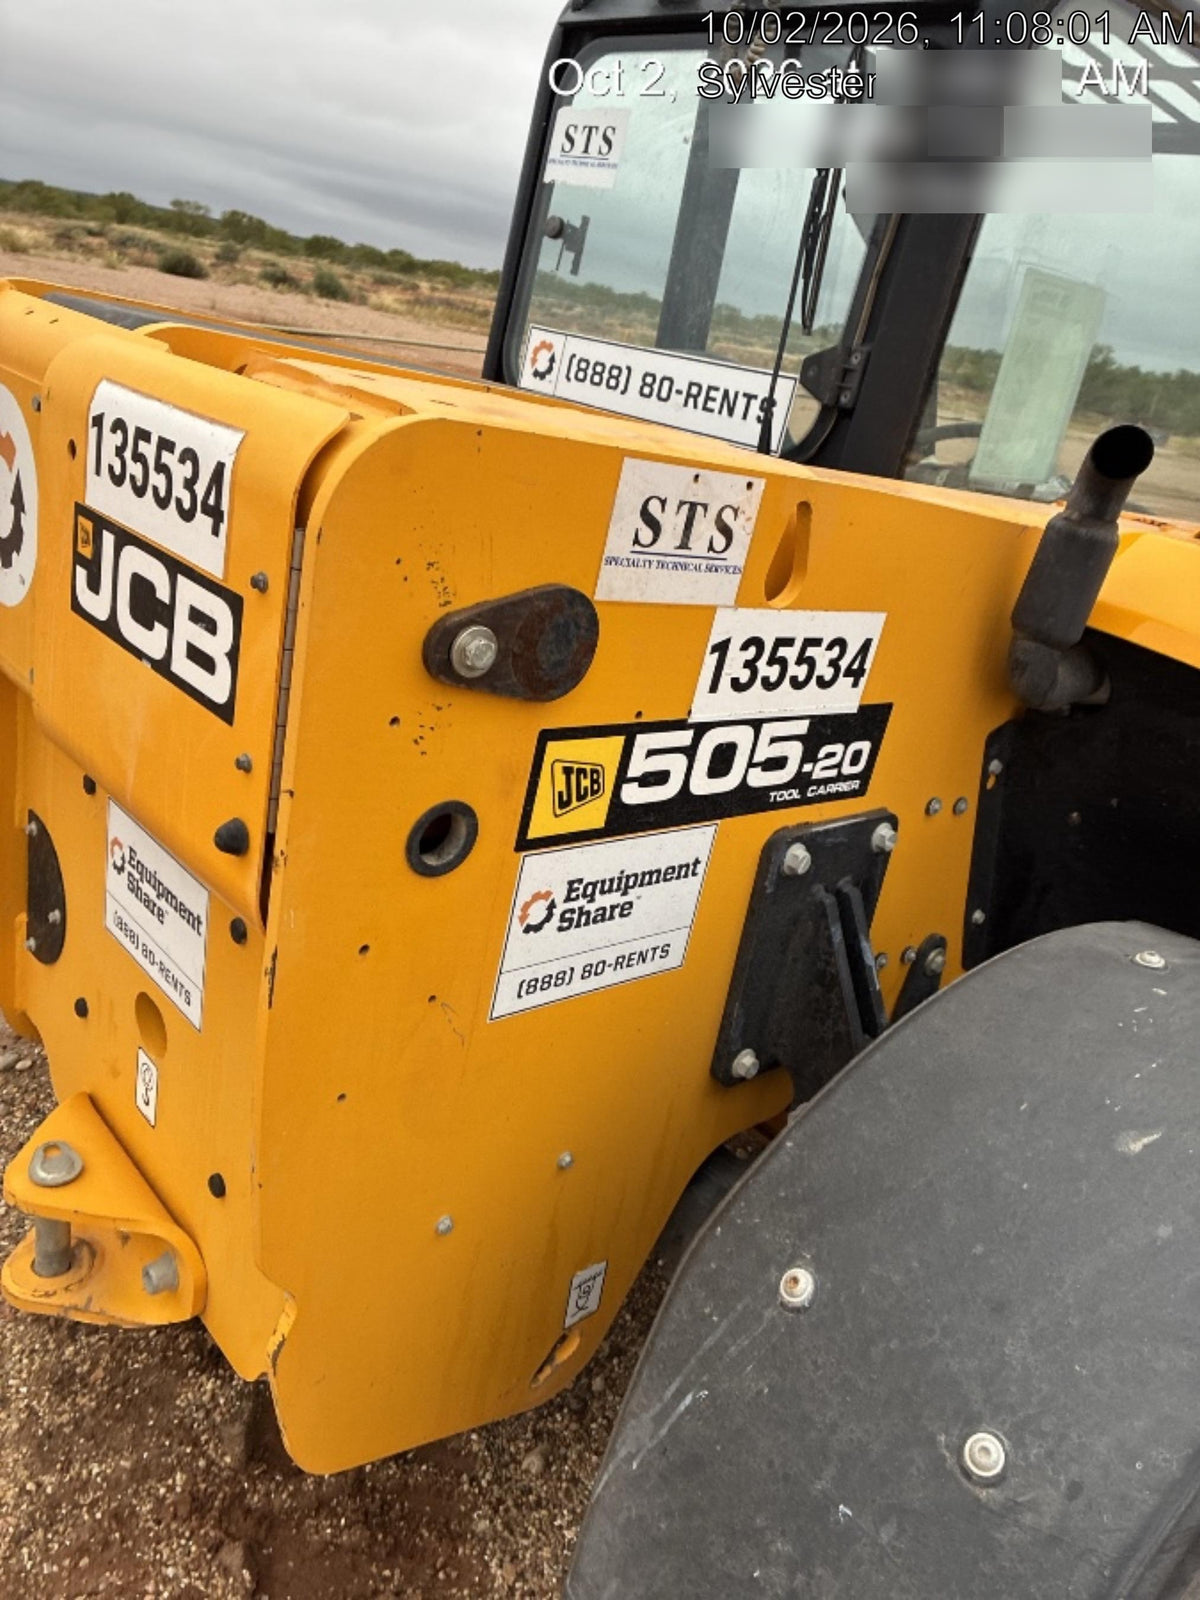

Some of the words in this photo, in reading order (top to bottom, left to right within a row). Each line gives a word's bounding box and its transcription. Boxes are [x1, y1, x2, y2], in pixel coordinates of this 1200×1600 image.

[560, 124, 616, 156] STS
[565, 353, 632, 395] (888)
[639, 372, 777, 425] 80-RENTS
[91, 412, 226, 538] 135534
[632, 495, 740, 554] STS
[603, 555, 653, 570] SPECIALTY
[75, 529, 234, 705] JCB
[708, 635, 874, 694] 135534
[557, 765, 602, 811] JCB
[620, 719, 872, 806] 505-20
[769, 789, 802, 803] TOOL
[126, 871, 165, 926] Share
[127, 846, 204, 937] Equipment
[562, 857, 702, 904] Equipment
[556, 899, 635, 933] Share
[141, 942, 192, 1008] 80-RENTS
[516, 966, 576, 1000] (888)
[580, 943, 672, 981] 80-RENTS
